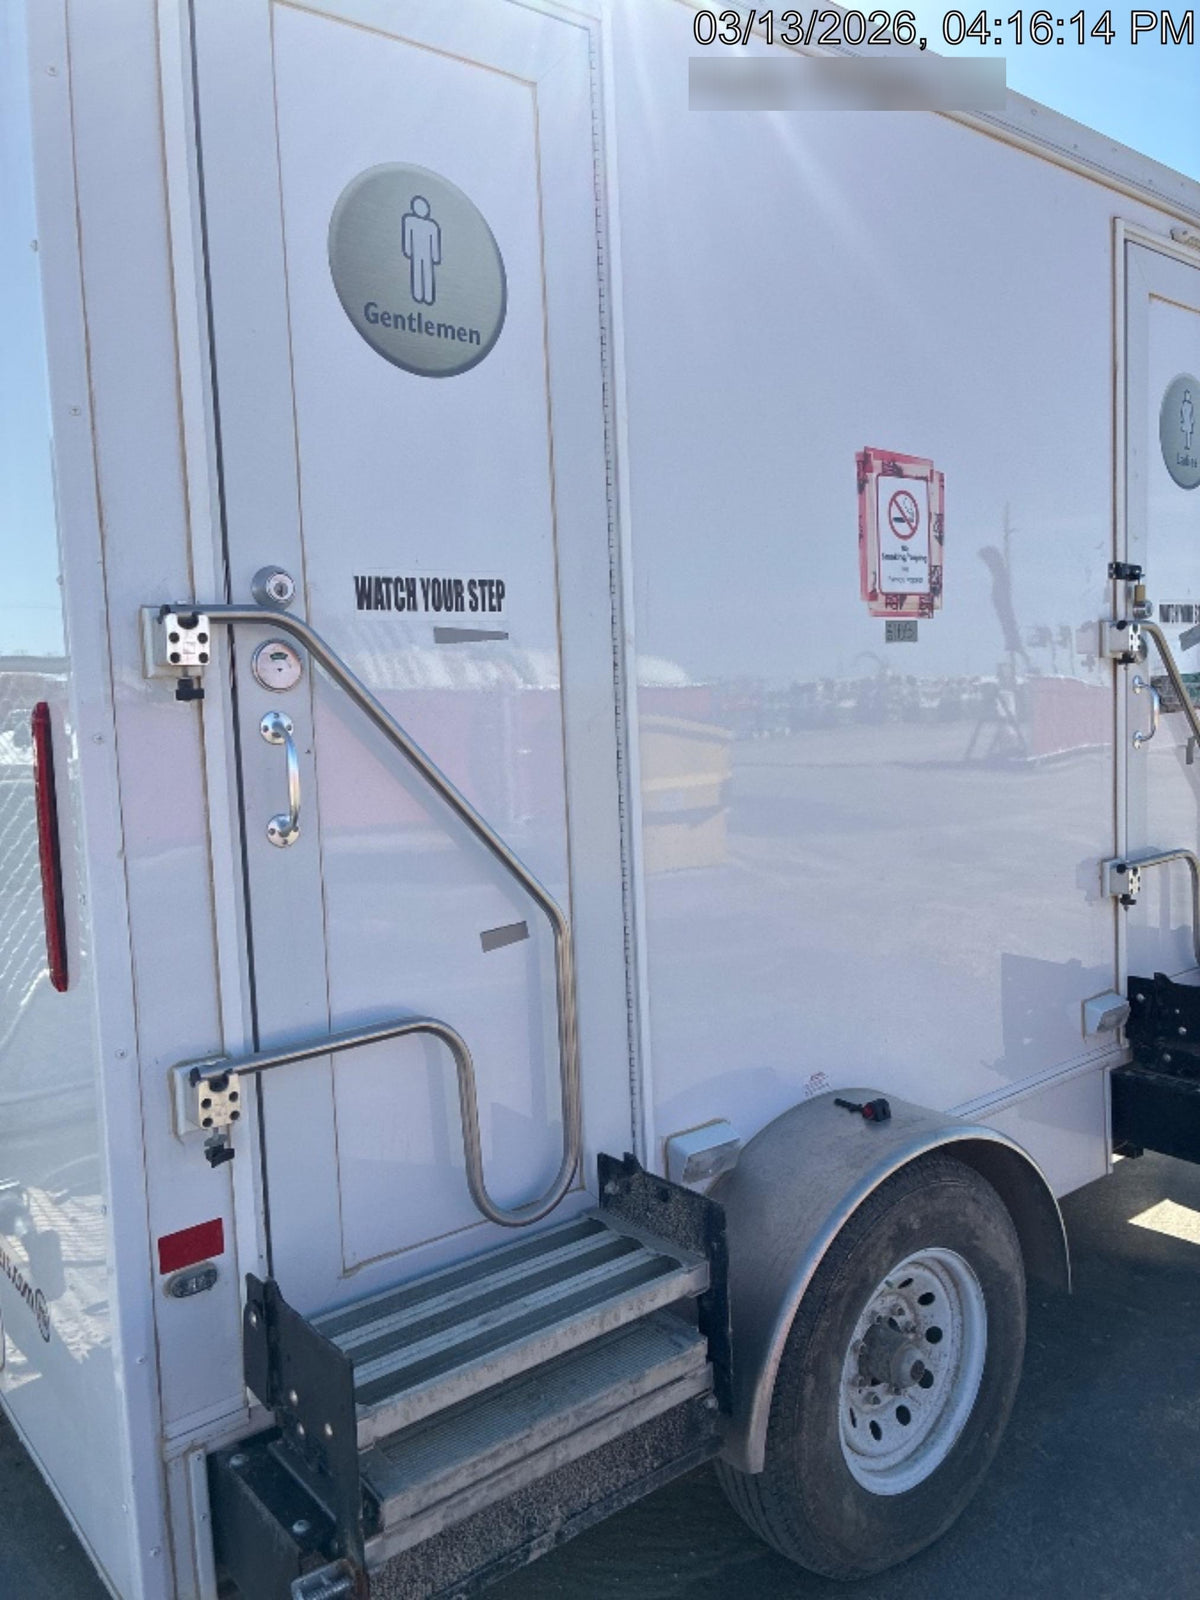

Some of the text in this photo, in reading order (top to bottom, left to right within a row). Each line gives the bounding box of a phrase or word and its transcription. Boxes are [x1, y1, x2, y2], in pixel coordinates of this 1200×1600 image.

[364, 301, 480, 346] Gentlemen
[353, 575, 506, 612] WATCH YOUR STEP
